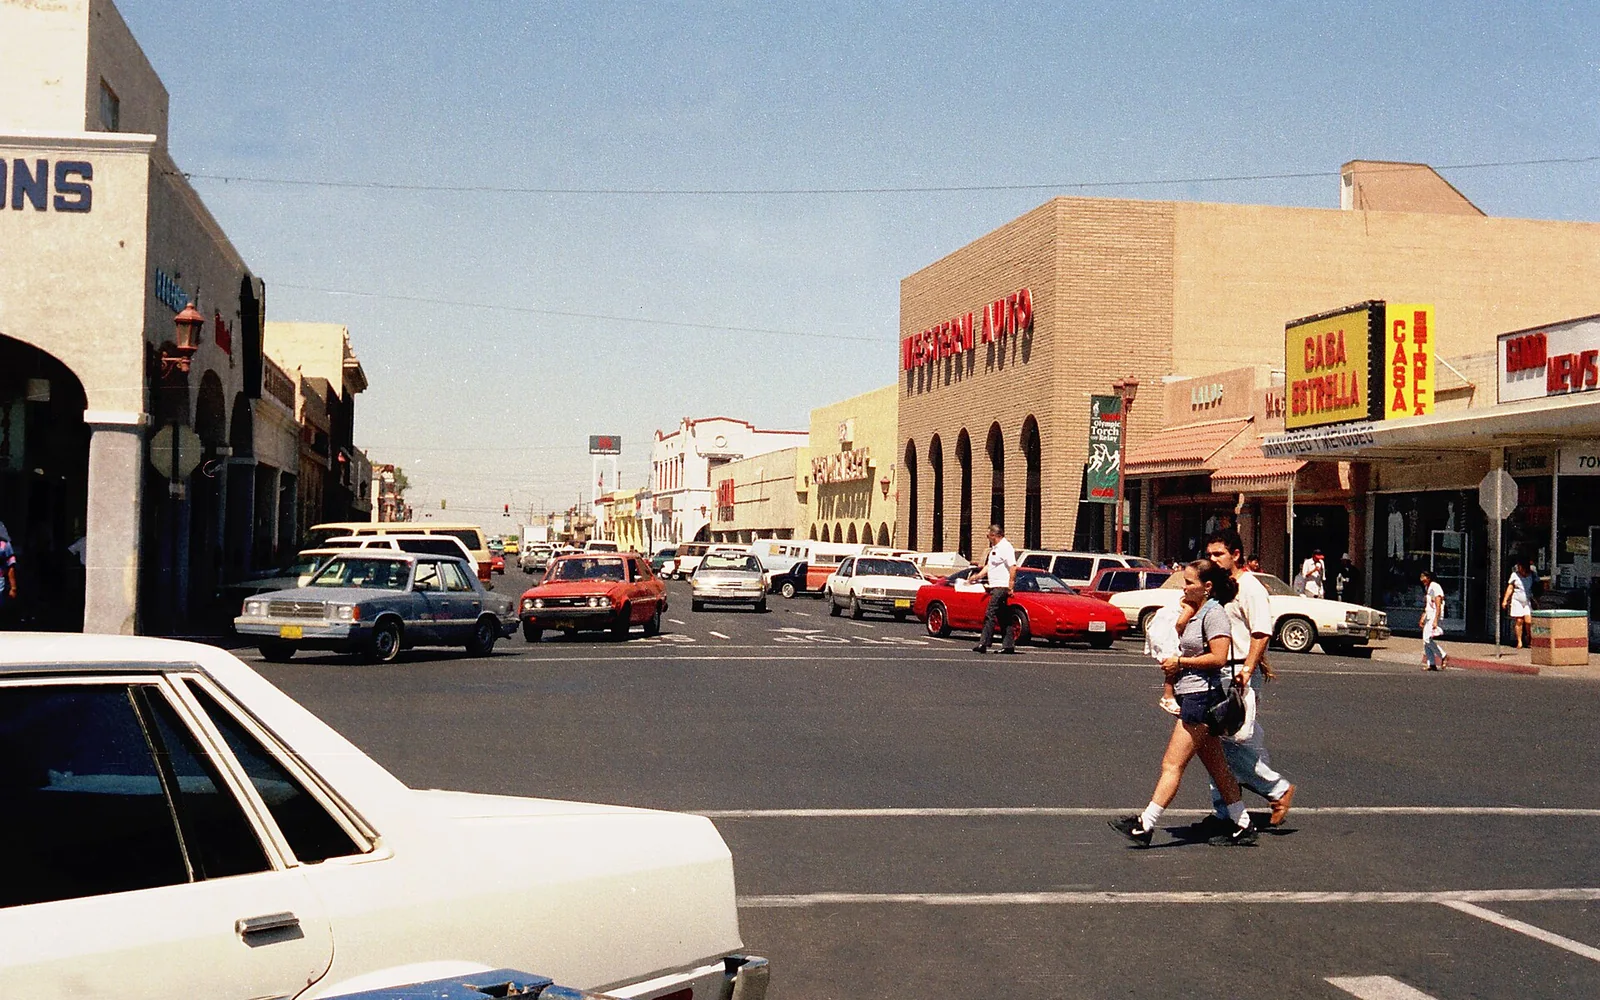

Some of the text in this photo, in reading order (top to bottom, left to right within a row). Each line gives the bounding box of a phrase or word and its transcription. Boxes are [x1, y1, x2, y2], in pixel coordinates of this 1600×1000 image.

[0, 158, 93, 213] NS
[902, 287, 1033, 371] WESTERN AUTO
[1304, 329, 1347, 373] CASA
[1392, 319, 1408, 412] CASA
[1546, 349, 1599, 392] NEWS
[1291, 370, 1360, 415] ESTRELLA
[1091, 426, 1119, 436] Torch
[1093, 420, 1121, 428] Olympic
[1099, 434, 1118, 443] Relay
[1578, 455, 1600, 468] TO
